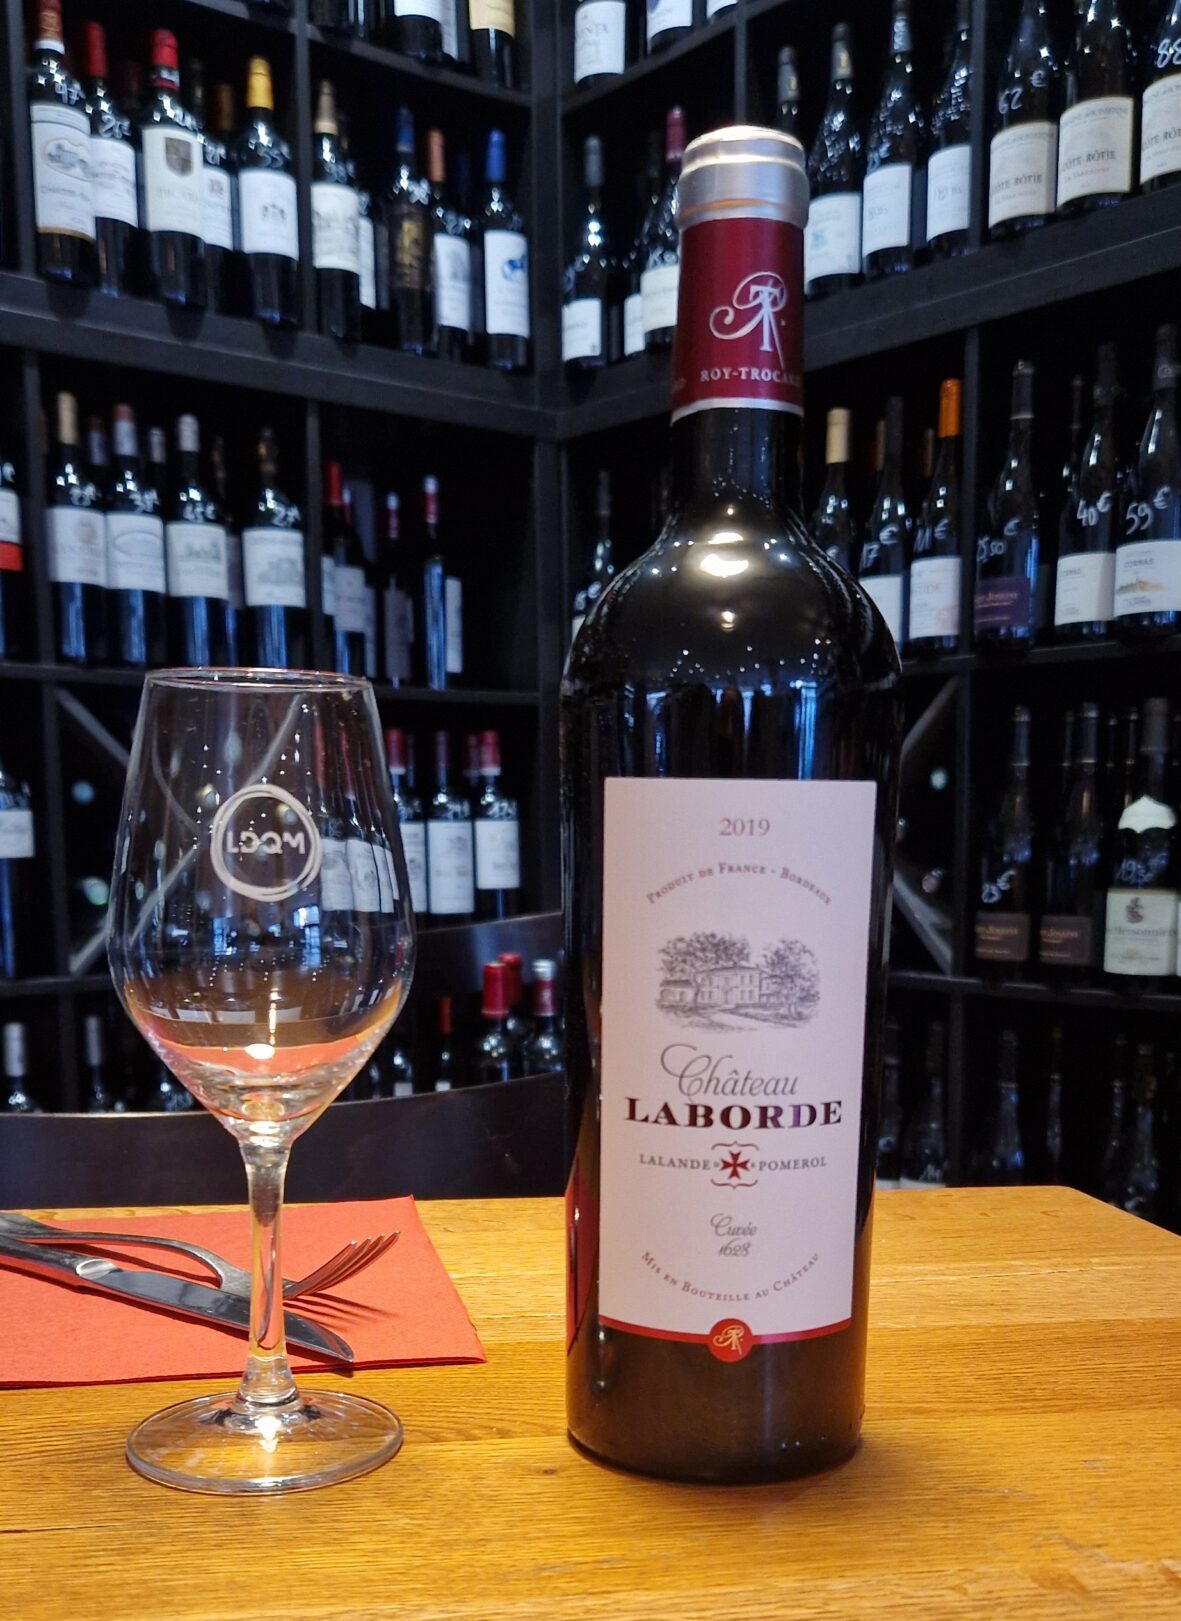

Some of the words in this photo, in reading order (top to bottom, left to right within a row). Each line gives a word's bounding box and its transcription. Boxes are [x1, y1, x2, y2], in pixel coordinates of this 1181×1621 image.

[719, 817, 772, 837] 2019
[646, 873, 694, 904] PRODUIT
[698, 868, 714, 878] DE
[718, 861, 767, 875] FRANCE
[780, 866, 832, 905] BORDEAUX
[660, 1043, 799, 1104] Château
[625, 1096, 843, 1131] LABORDE
[639, 1153, 712, 1171] LALANDE
[758, 1156, 829, 1172] POMEROL
[710, 1213, 758, 1238] Cuvée
[717, 1238, 752, 1257] 1628
[681, 1280, 750, 1301] BOUTEILLE
[755, 1288, 769, 1299] AU
